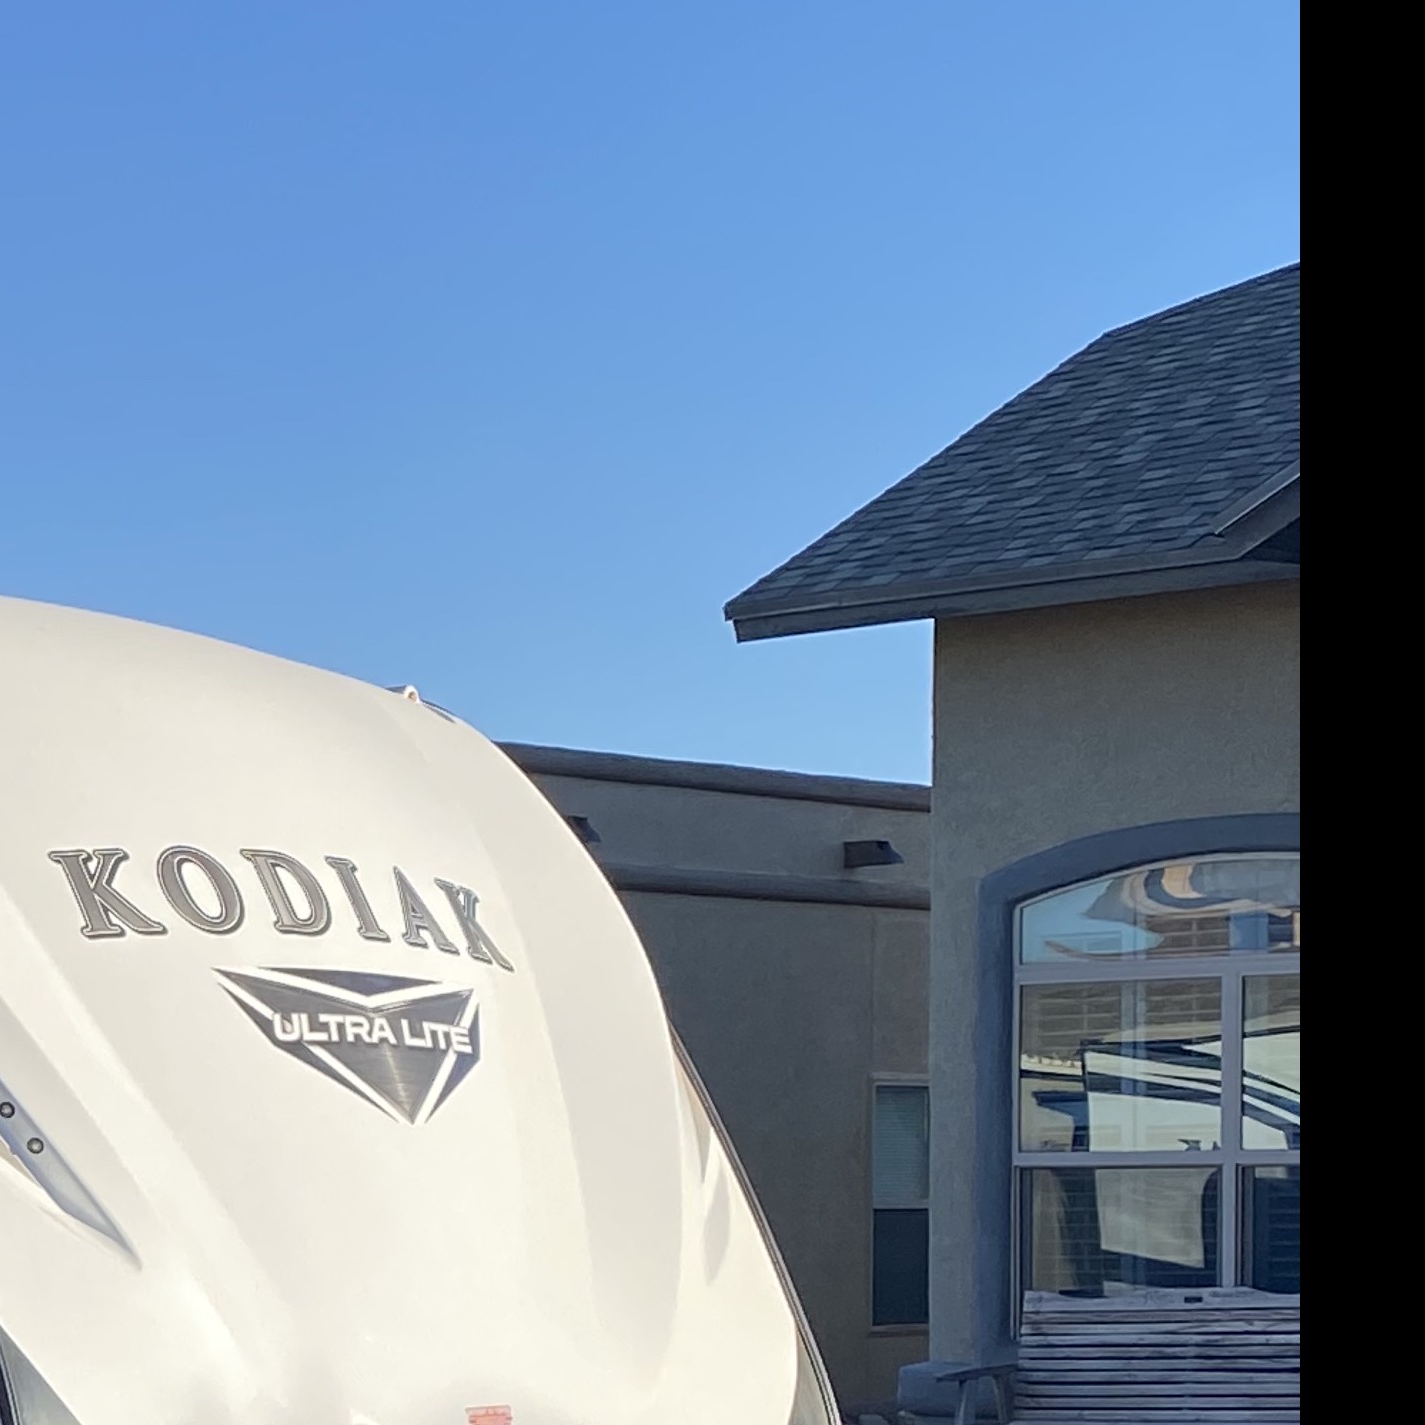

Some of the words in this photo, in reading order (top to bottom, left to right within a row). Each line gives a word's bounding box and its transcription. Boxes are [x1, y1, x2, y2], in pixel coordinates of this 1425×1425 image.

[48, 844, 515, 973] KODIAK
[272, 1011, 398, 1046] ULTRA
[400, 1017, 474, 1055] LITE
